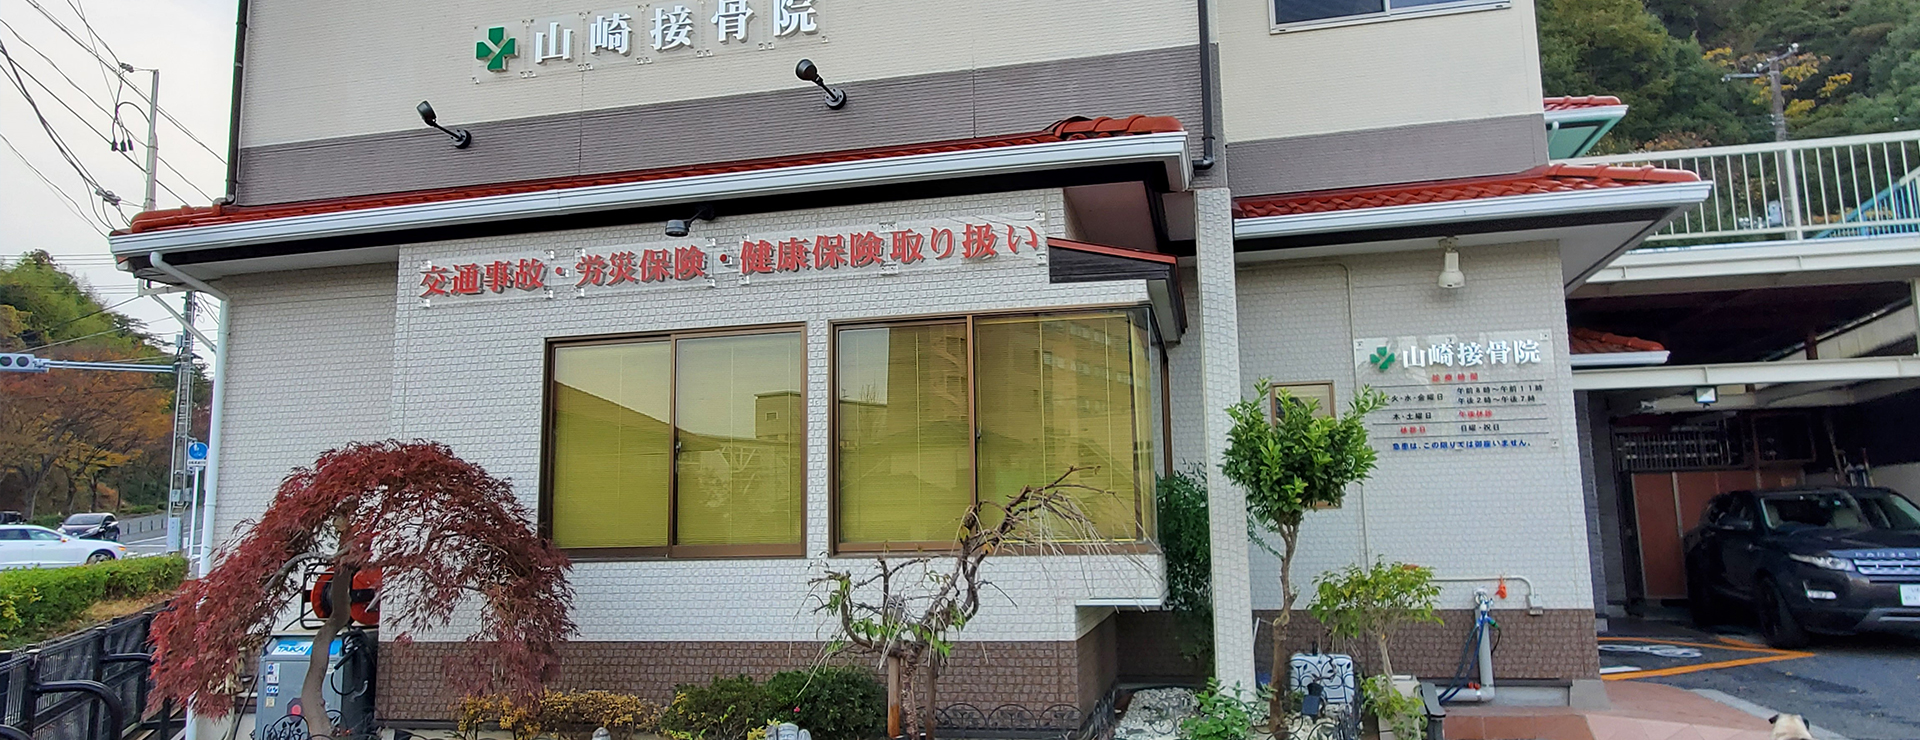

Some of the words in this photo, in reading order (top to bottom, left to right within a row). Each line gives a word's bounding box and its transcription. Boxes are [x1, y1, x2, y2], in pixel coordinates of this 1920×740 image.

[534, 0, 818, 64] 山崎接骨院
[1402, 340, 1541, 368] 山崎接骨院
